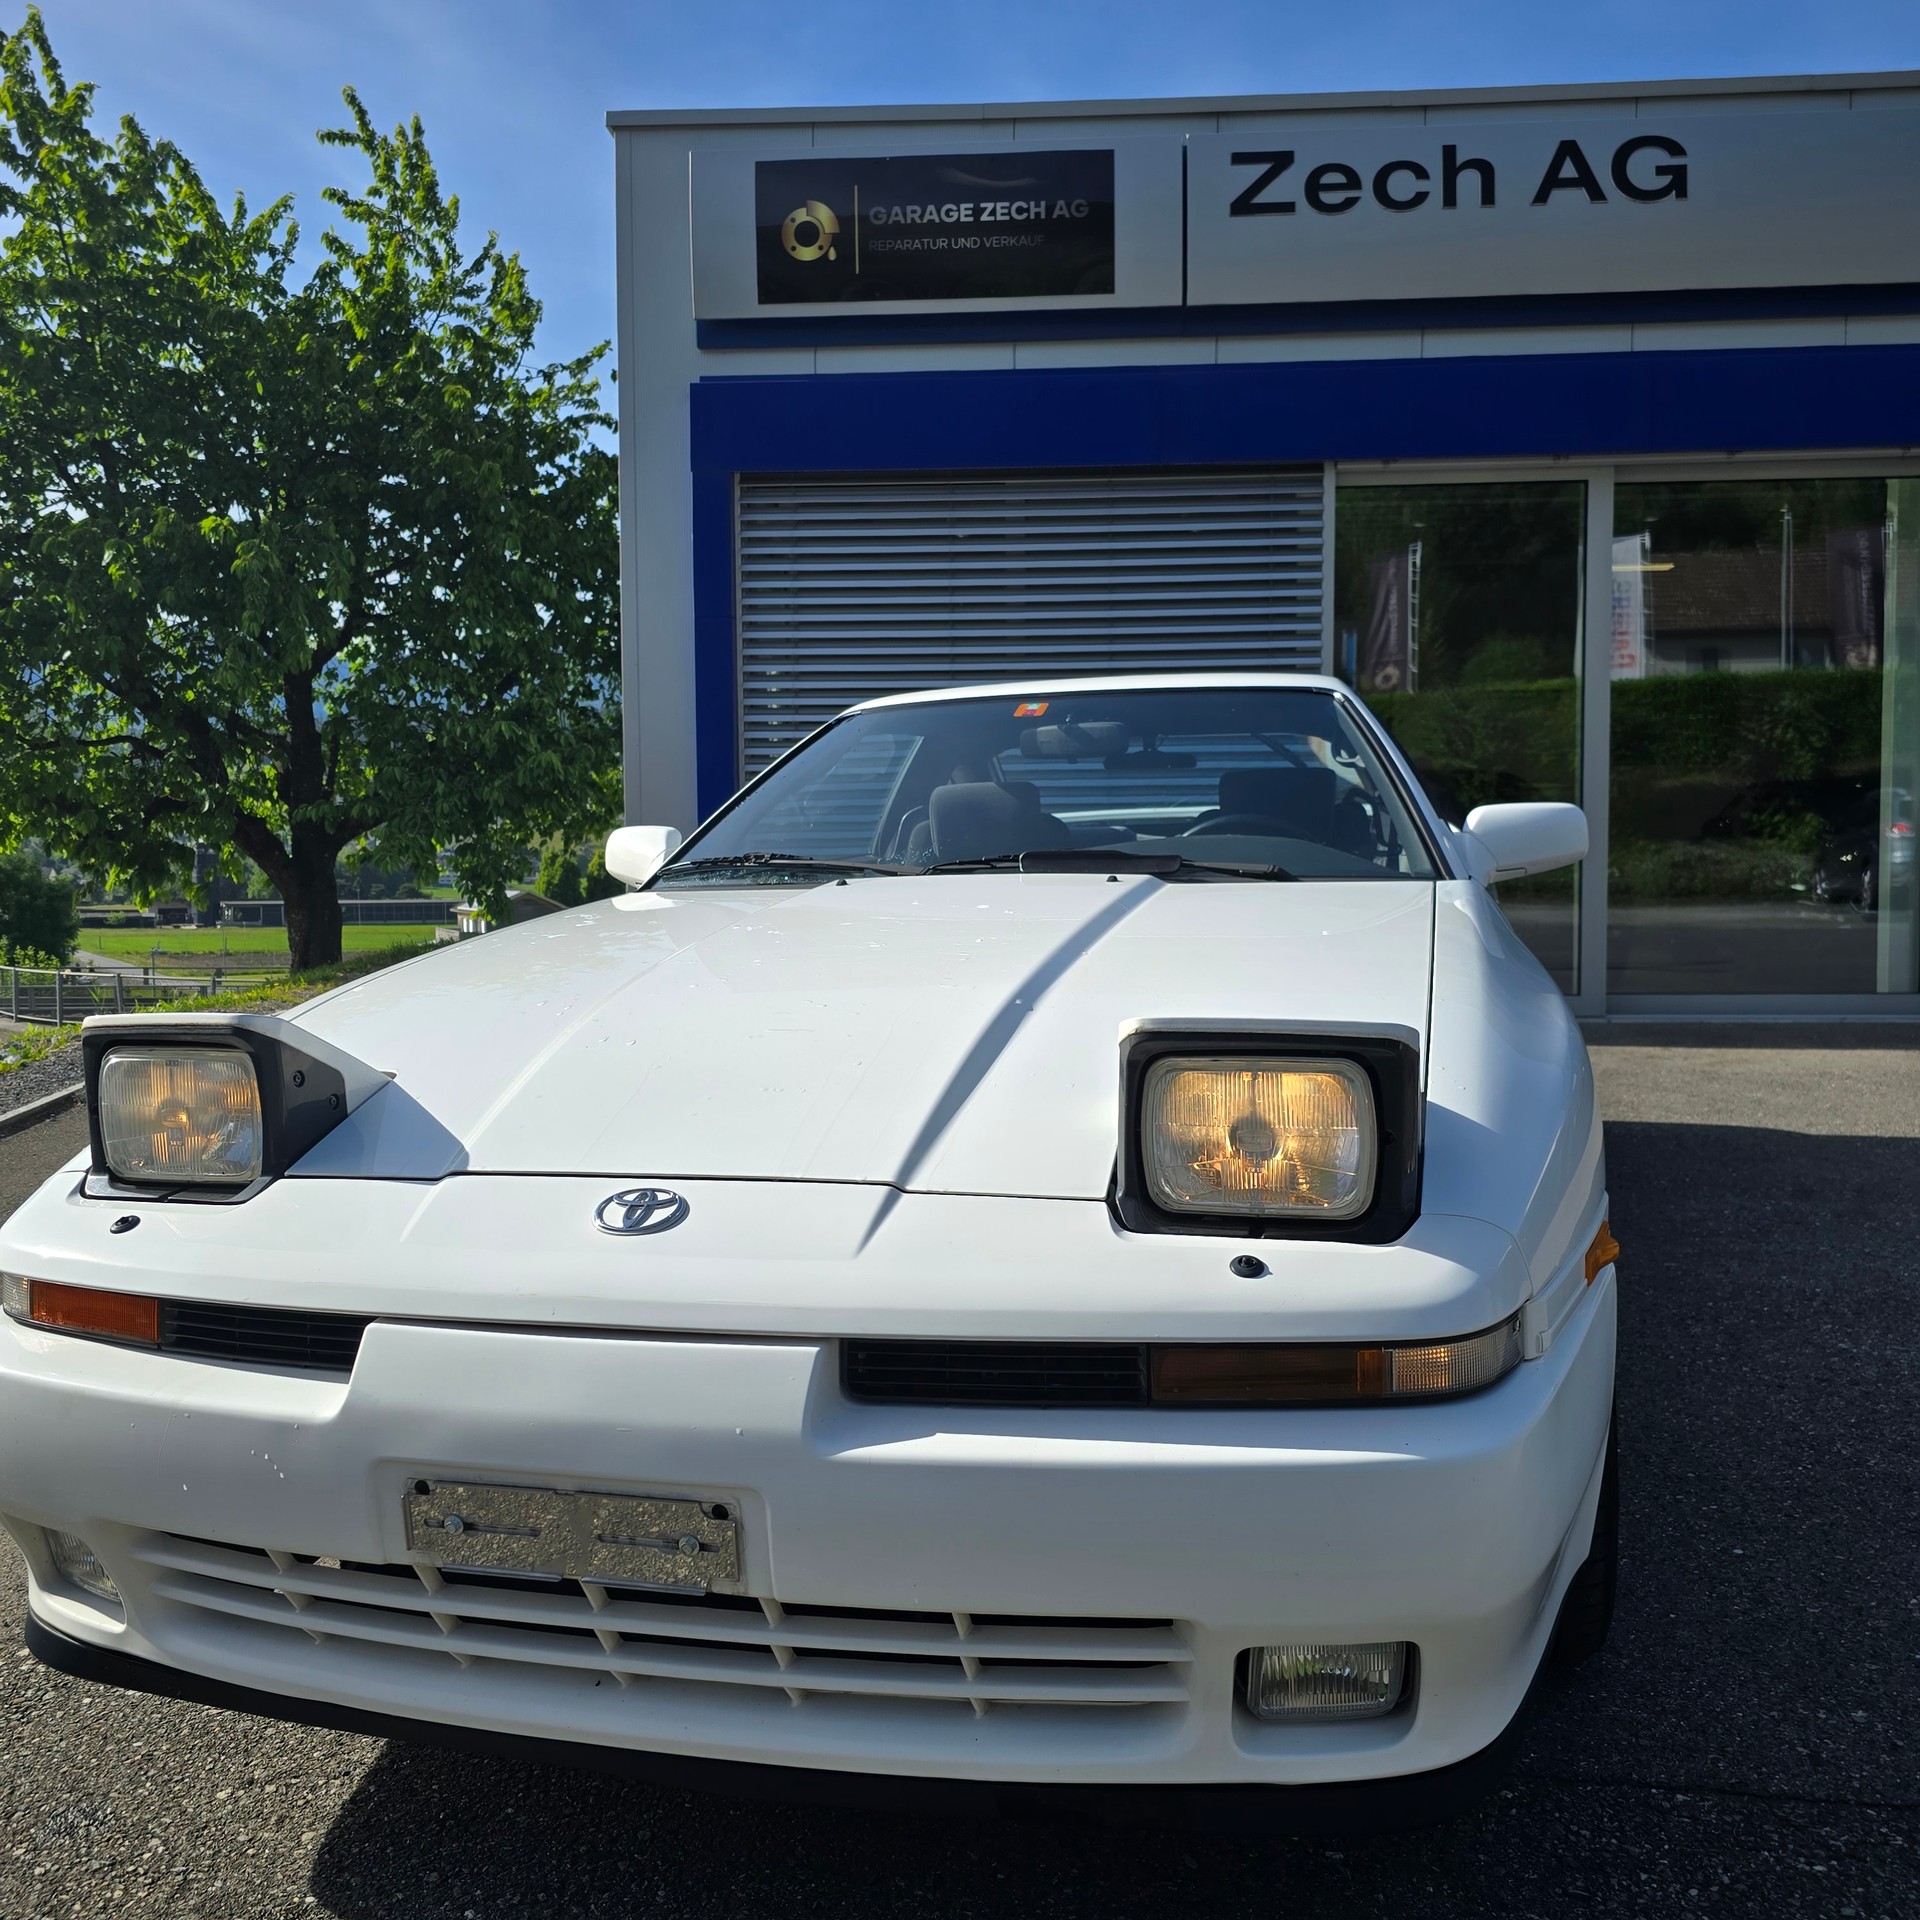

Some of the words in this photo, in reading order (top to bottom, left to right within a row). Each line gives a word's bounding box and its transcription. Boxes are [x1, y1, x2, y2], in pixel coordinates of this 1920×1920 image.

[1229, 144, 1496, 216] Zech
[1529, 135, 1688, 206] AG
[868, 204, 974, 225] GARAGE
[979, 200, 1046, 222] ZECH
[1052, 199, 1089, 218] AG
[868, 239, 949, 251] REPARATUR
[951, 237, 980, 250] UND
[983, 234, 1045, 248] VERKAUF
